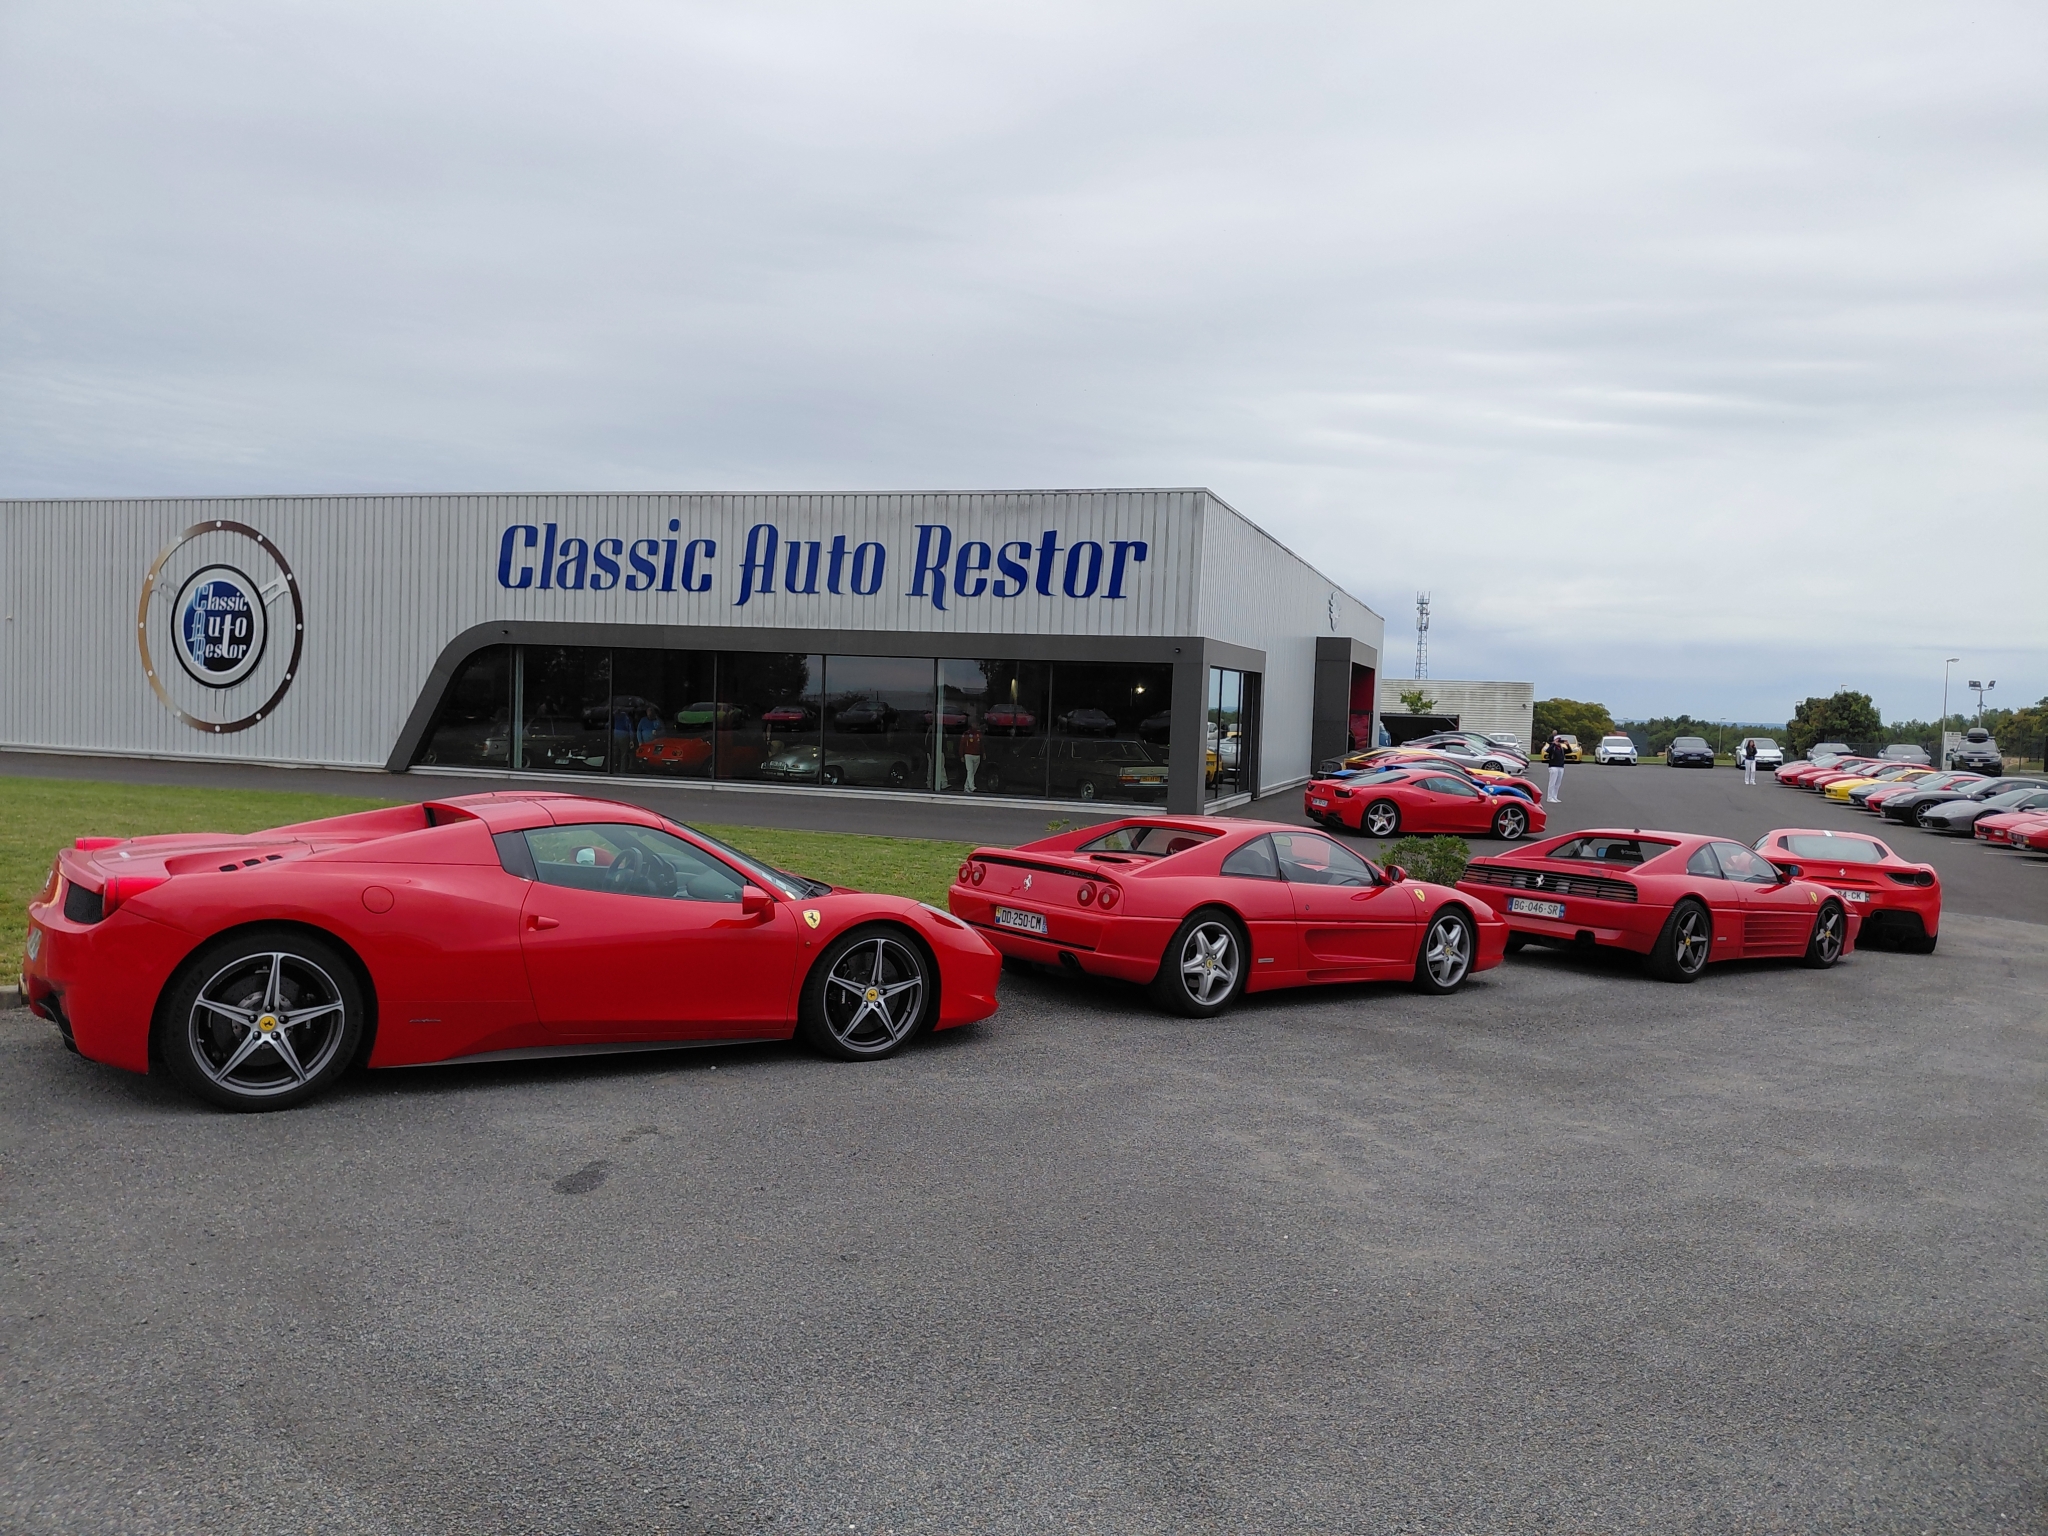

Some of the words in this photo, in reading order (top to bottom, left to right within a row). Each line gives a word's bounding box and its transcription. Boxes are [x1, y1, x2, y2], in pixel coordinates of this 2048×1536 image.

[498, 518, 716, 592] Classic
[733, 523, 886, 606] Auto
[905, 524, 1148, 611] Restor
[193, 585, 247, 611] Classic
[188, 611, 247, 642] Auto
[192, 638, 247, 669] Restor
[1002, 910, 1042, 930] DD-250-CM
[1513, 899, 1559, 916] BG-046-SR
